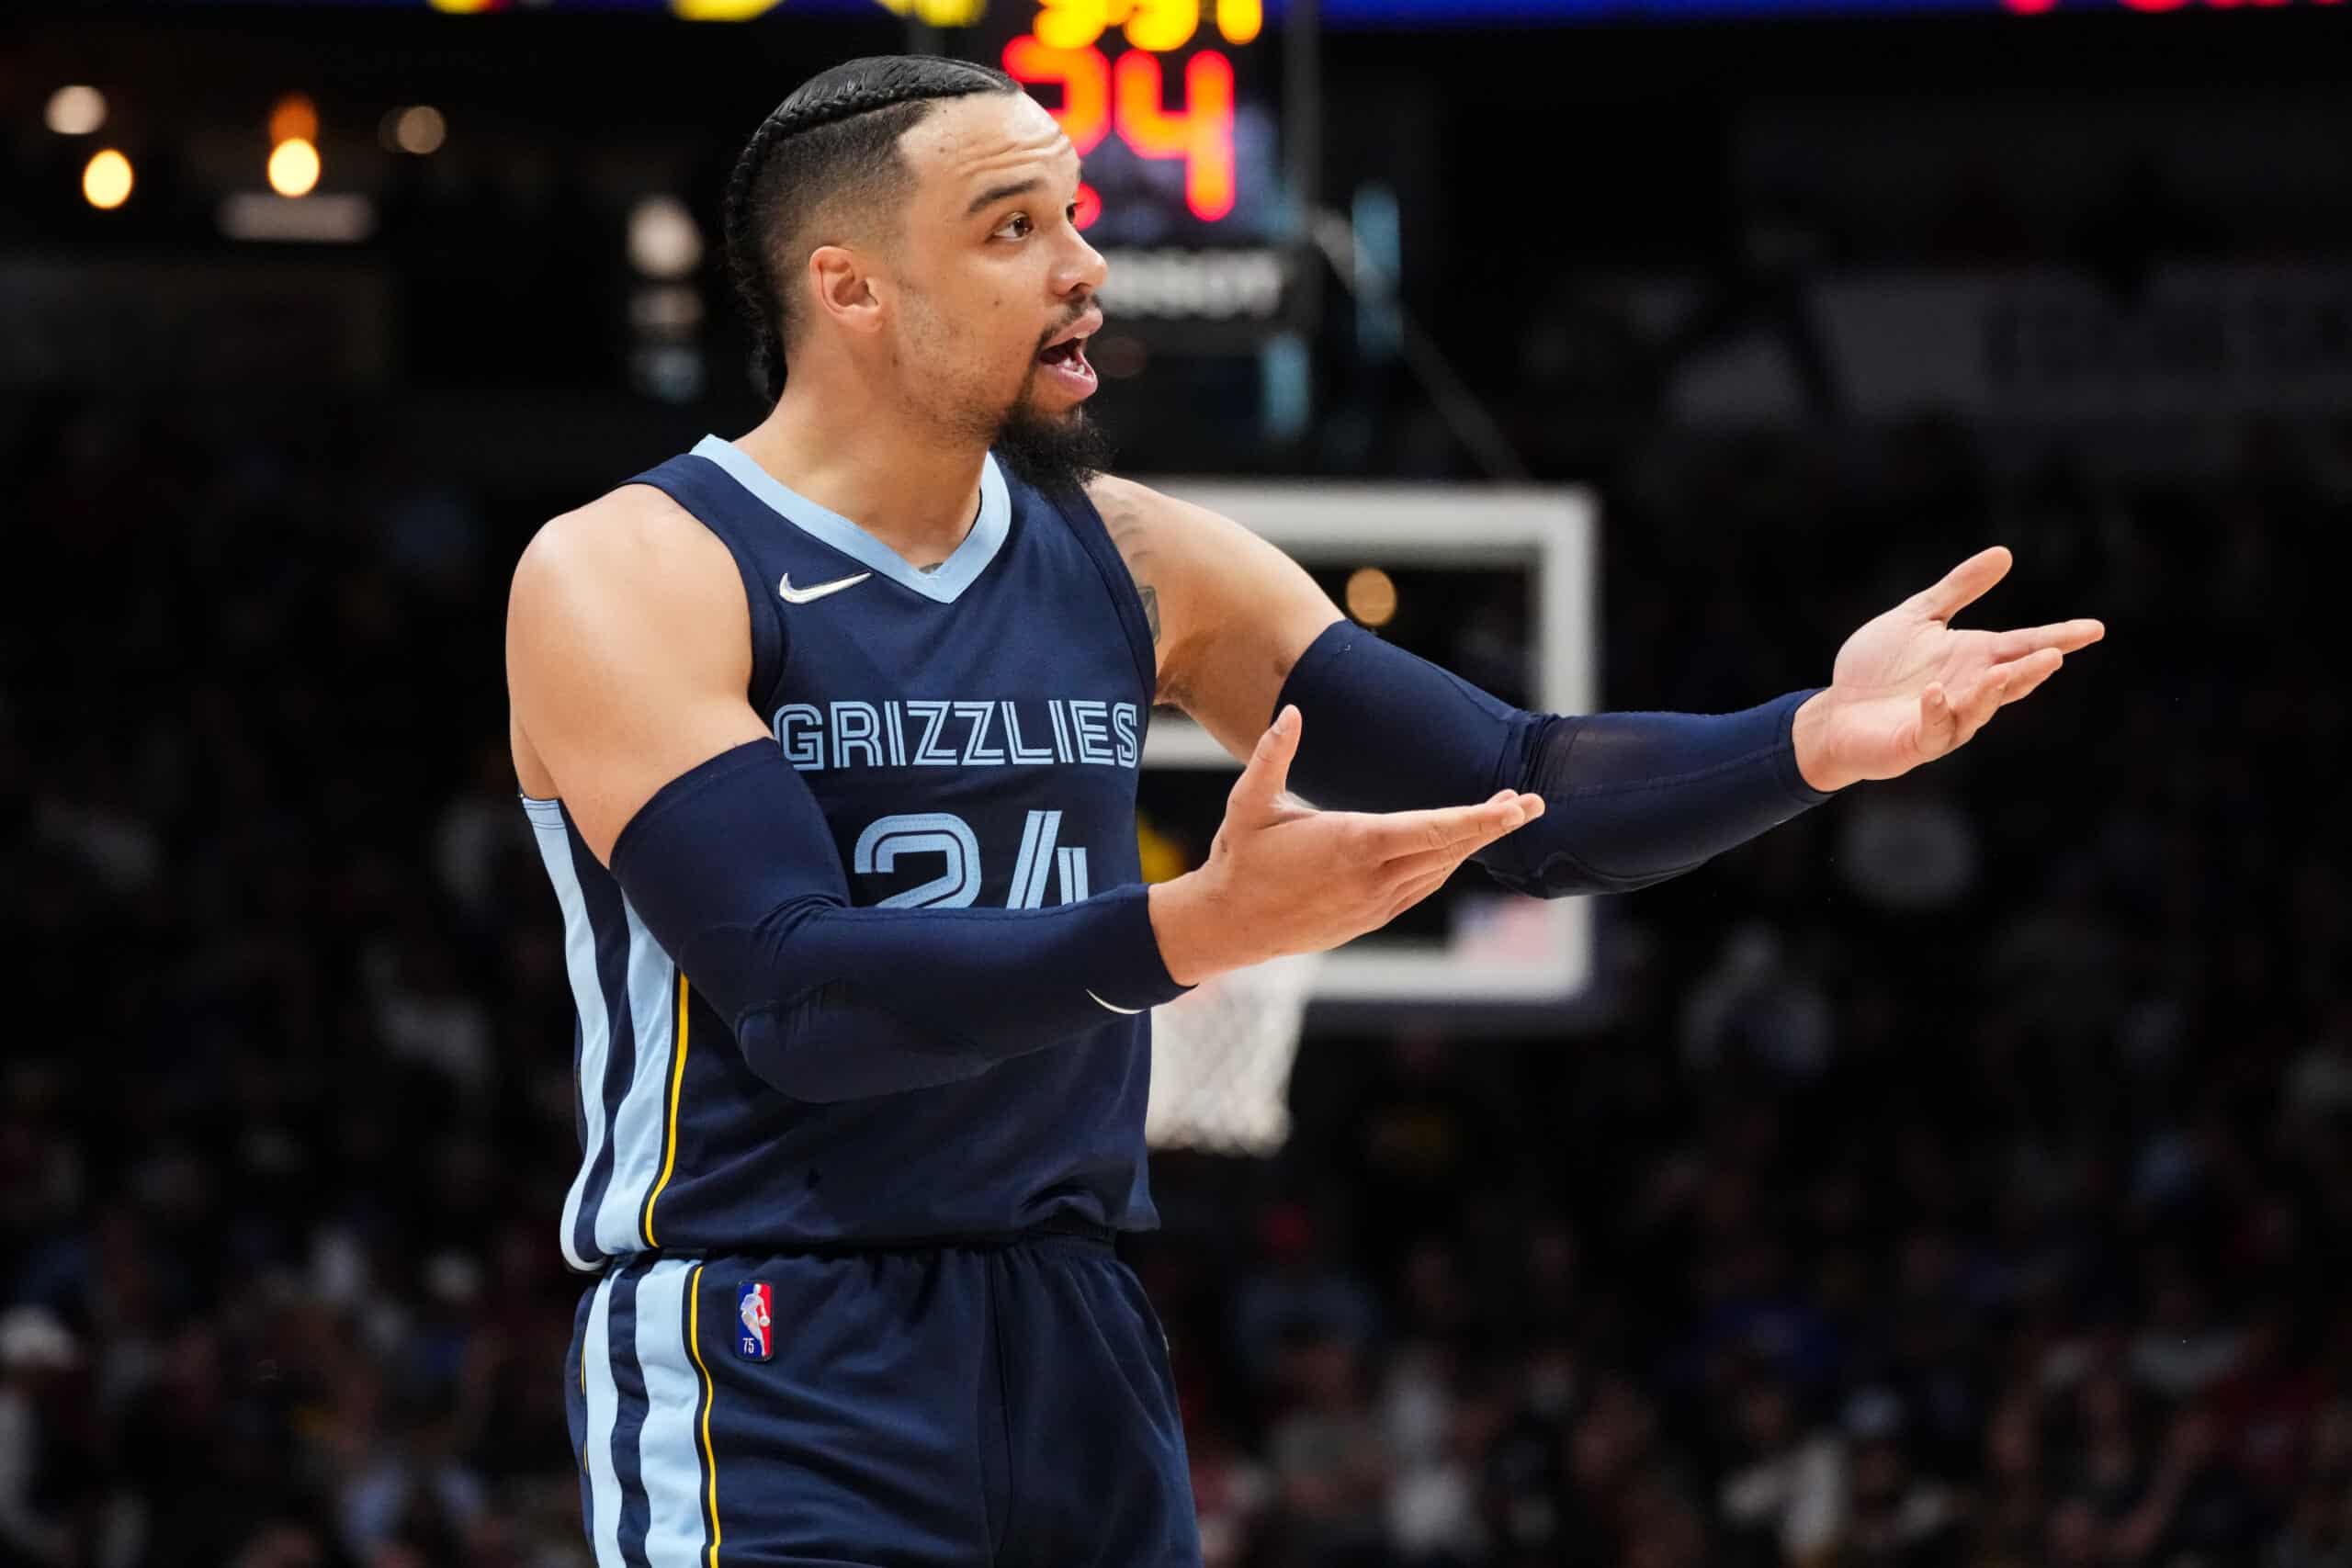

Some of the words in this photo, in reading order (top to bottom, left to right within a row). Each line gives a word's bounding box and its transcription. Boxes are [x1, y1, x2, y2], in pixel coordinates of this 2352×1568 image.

[773, 700, 1138, 771] GRIZZLIES
[854, 809, 1090, 910] 24
[742, 1337, 755, 1354] 75
